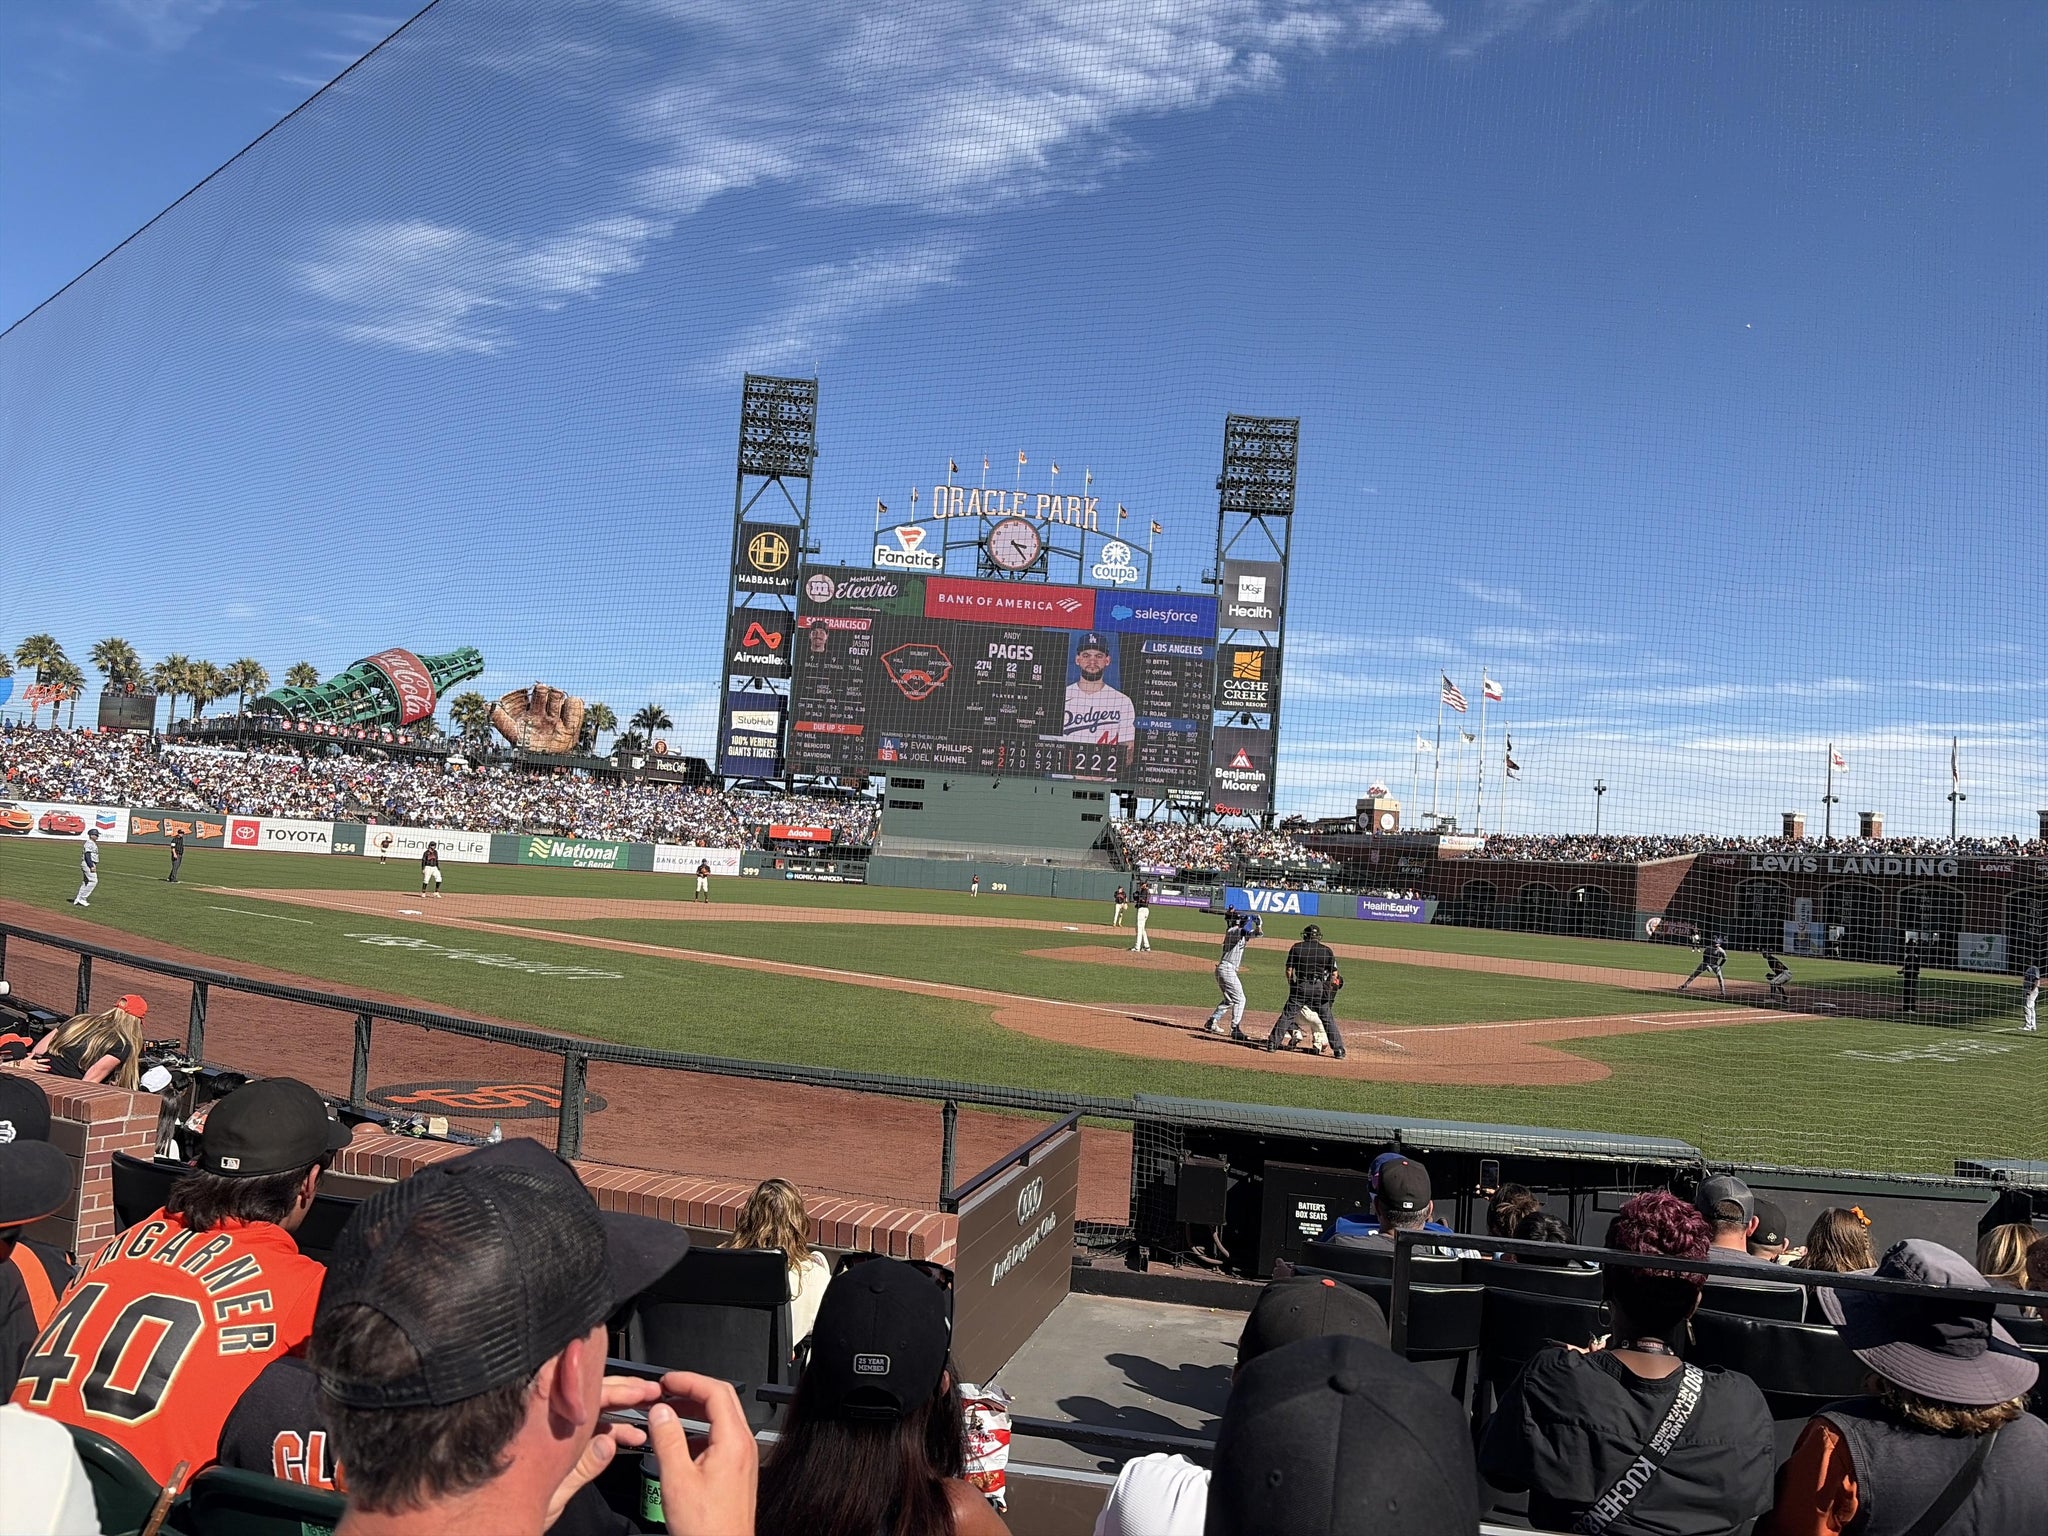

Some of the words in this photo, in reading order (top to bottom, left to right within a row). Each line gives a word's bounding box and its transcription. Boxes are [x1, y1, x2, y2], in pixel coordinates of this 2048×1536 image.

[933, 485, 1027, 519] ORACLE
[1035, 494, 1099, 532] PARK
[877, 549, 942, 568] Fanatics
[738, 574, 774, 585] HABBAS
[1095, 565, 1136, 583] coupa
[836, 582, 898, 599] Electric
[1241, 584, 1262, 595] UCSF
[939, 593, 973, 605] BANK
[977, 596, 993, 607] OF
[995, 598, 1053, 611] AMERICA
[1135, 608, 1198, 624] salesforce
[1228, 604, 1272, 619] Health
[1004, 632, 1020, 640] ANDY
[852, 640, 870, 648] JASON
[1152, 643, 1167, 652] LOS
[1168, 645, 1203, 654] ANGELES
[849, 647, 869, 656] FOLEY
[988, 643, 1033, 660] PAGES
[734, 651, 786, 666] Airwallex
[974, 661, 992, 671] .274
[1006, 663, 1017, 672] 22
[1033, 665, 1042, 674] 81
[1223, 680, 1269, 691] CACHE
[1224, 690, 1267, 701] CREEK
[738, 715, 774, 727] StubHub
[1064, 706, 1120, 733] Dodgers
[1150, 721, 1172, 729] PAGES
[813, 723, 826, 731] DUE
[731, 735, 749, 746] 100%
[749, 736, 777, 748] VERIFIED
[803, 741, 831, 750] BERICOTO
[900, 741, 908, 749] 59
[910, 741, 932, 751] EVAN
[936, 743, 973, 754] PHILLIPS
[728, 746, 752, 757] GIANTS
[752, 747, 778, 759] TICKETS
[999, 747, 1006, 757] 3
[1009, 748, 1015, 757] 7
[1020, 749, 1026, 758] 0
[1035, 750, 1041, 759] 6
[1046, 750, 1052, 760] 4
[1058, 752, 1062, 760] 1
[909, 753, 930, 762] JOEL
[933, 754, 967, 765] KUHNEL
[997, 758, 1004, 768] 2
[1008, 759, 1015, 768] 7
[1019, 759, 1026, 769] 0
[1035, 760, 1041, 770] 5
[1045, 761, 1052, 771] 2
[1075, 753, 1086, 770] 2
[1091, 754, 1102, 771] 2
[1107, 756, 1117, 772] 2
[656, 759, 673, 772] Peet's
[1215, 768, 1266, 781] Benjamin
[1222, 780, 1258, 792] Moore
[1215, 803, 1242, 816] Coors
[1242, 807, 1265, 817] LIGHT
[266, 828, 328, 843] TOYOTA
[787, 829, 814, 838] Adobe
[334, 842, 356, 853] 354
[458, 841, 484, 853] Life
[551, 841, 619, 861] National
[572, 859, 587, 868] Car
[588, 861, 615, 869] Rental
[656, 857, 677, 865] BANK
[1751, 856, 1818, 873] Levi's
[1828, 857, 1958, 877] LANDING
[742, 867, 760, 876] 399
[794, 873, 818, 881] KONICA
[817, 874, 844, 882] MINOLTA
[991, 882, 1007, 891] 391
[1242, 889, 1301, 914] VISA
[1363, 901, 1420, 915] HealthEquity
[1298, 1202, 1326, 1212] BATTER'S
[1295, 1210, 1309, 1219] BOX
[1309, 1211, 1328, 1221] SEATS
[991, 1249, 1013, 1287] Audi
[1011, 1226, 1041, 1263] Dugout
[1040, 1211, 1057, 1239] Club
[17, 1282, 206, 1427] 40
[858, 1357, 867, 1365] 25
[857, 1364, 885, 1372] MEMBER
[1648, 1385, 1689, 1450] NEWFASHION
[272, 1430, 348, 1493] GL
